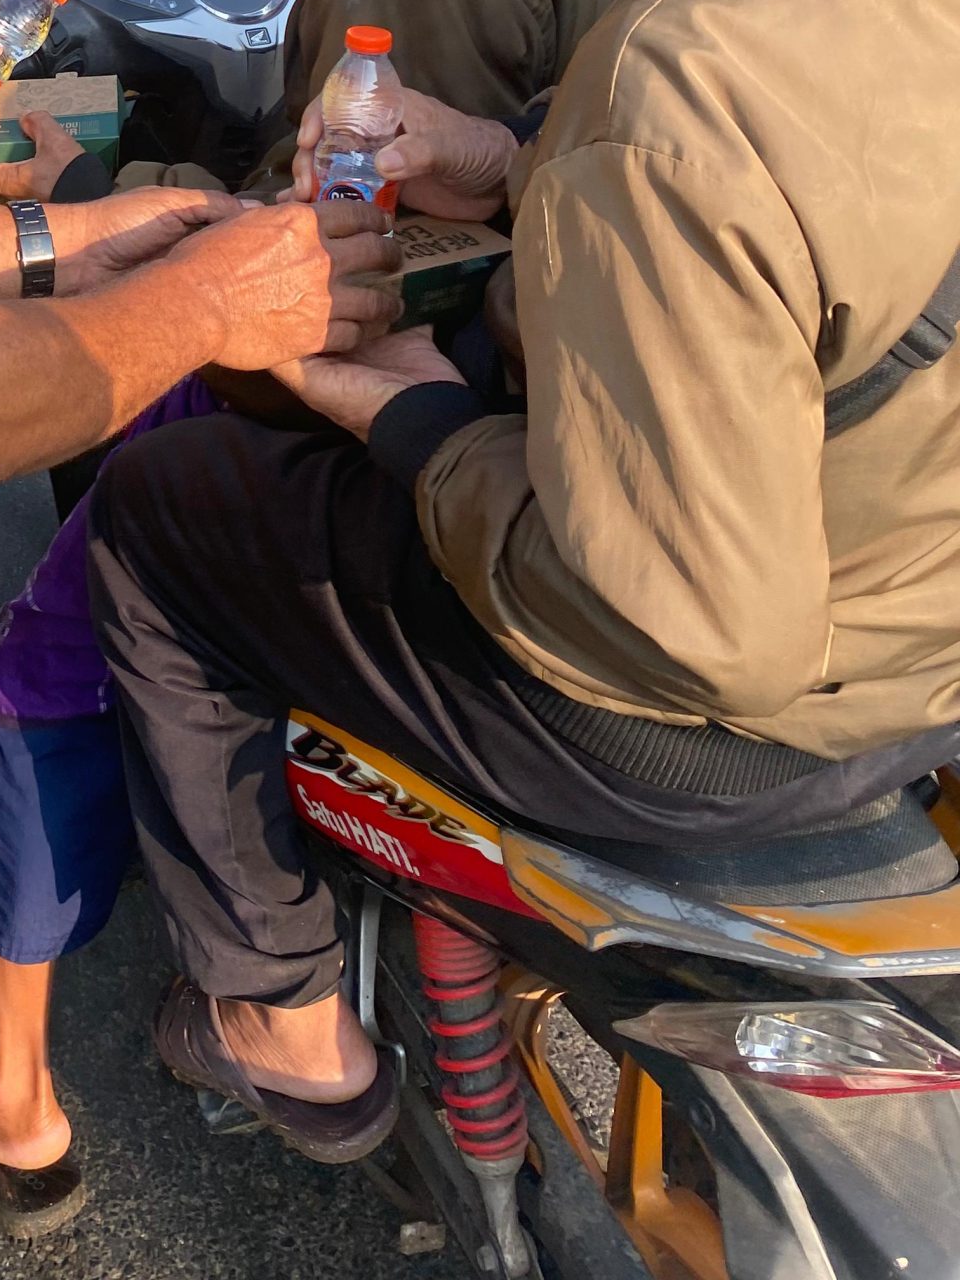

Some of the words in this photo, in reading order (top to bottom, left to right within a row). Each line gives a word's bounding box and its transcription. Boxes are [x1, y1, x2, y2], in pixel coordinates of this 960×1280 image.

[290, 726, 478, 845] BLADE
[296, 783, 352, 841] Satu
[342, 810, 421, 877] HATI.
